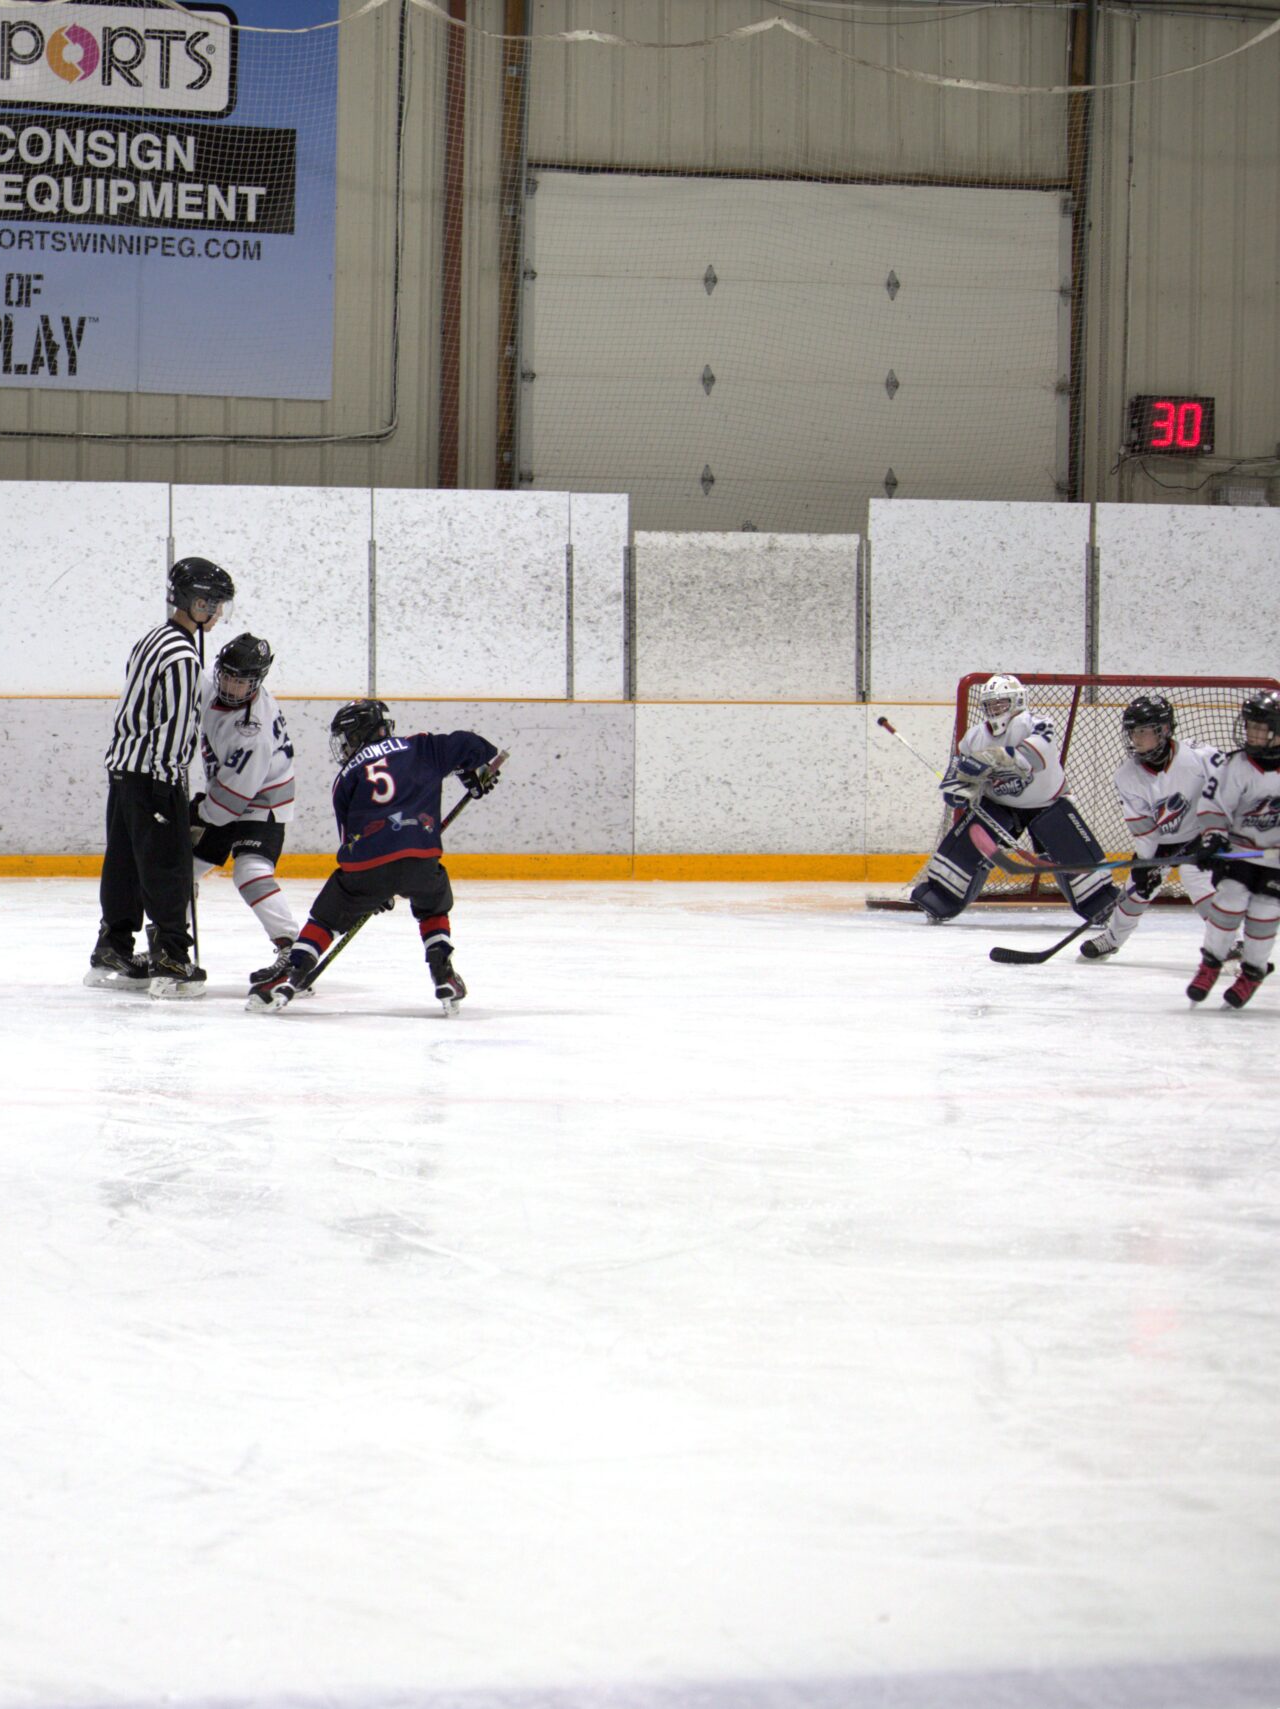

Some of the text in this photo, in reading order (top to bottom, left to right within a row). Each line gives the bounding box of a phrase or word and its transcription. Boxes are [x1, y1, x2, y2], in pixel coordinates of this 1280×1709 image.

[5, 272, 45, 308] OF
[1150, 402, 1202, 447] 30
[366, 757, 396, 805] 5
